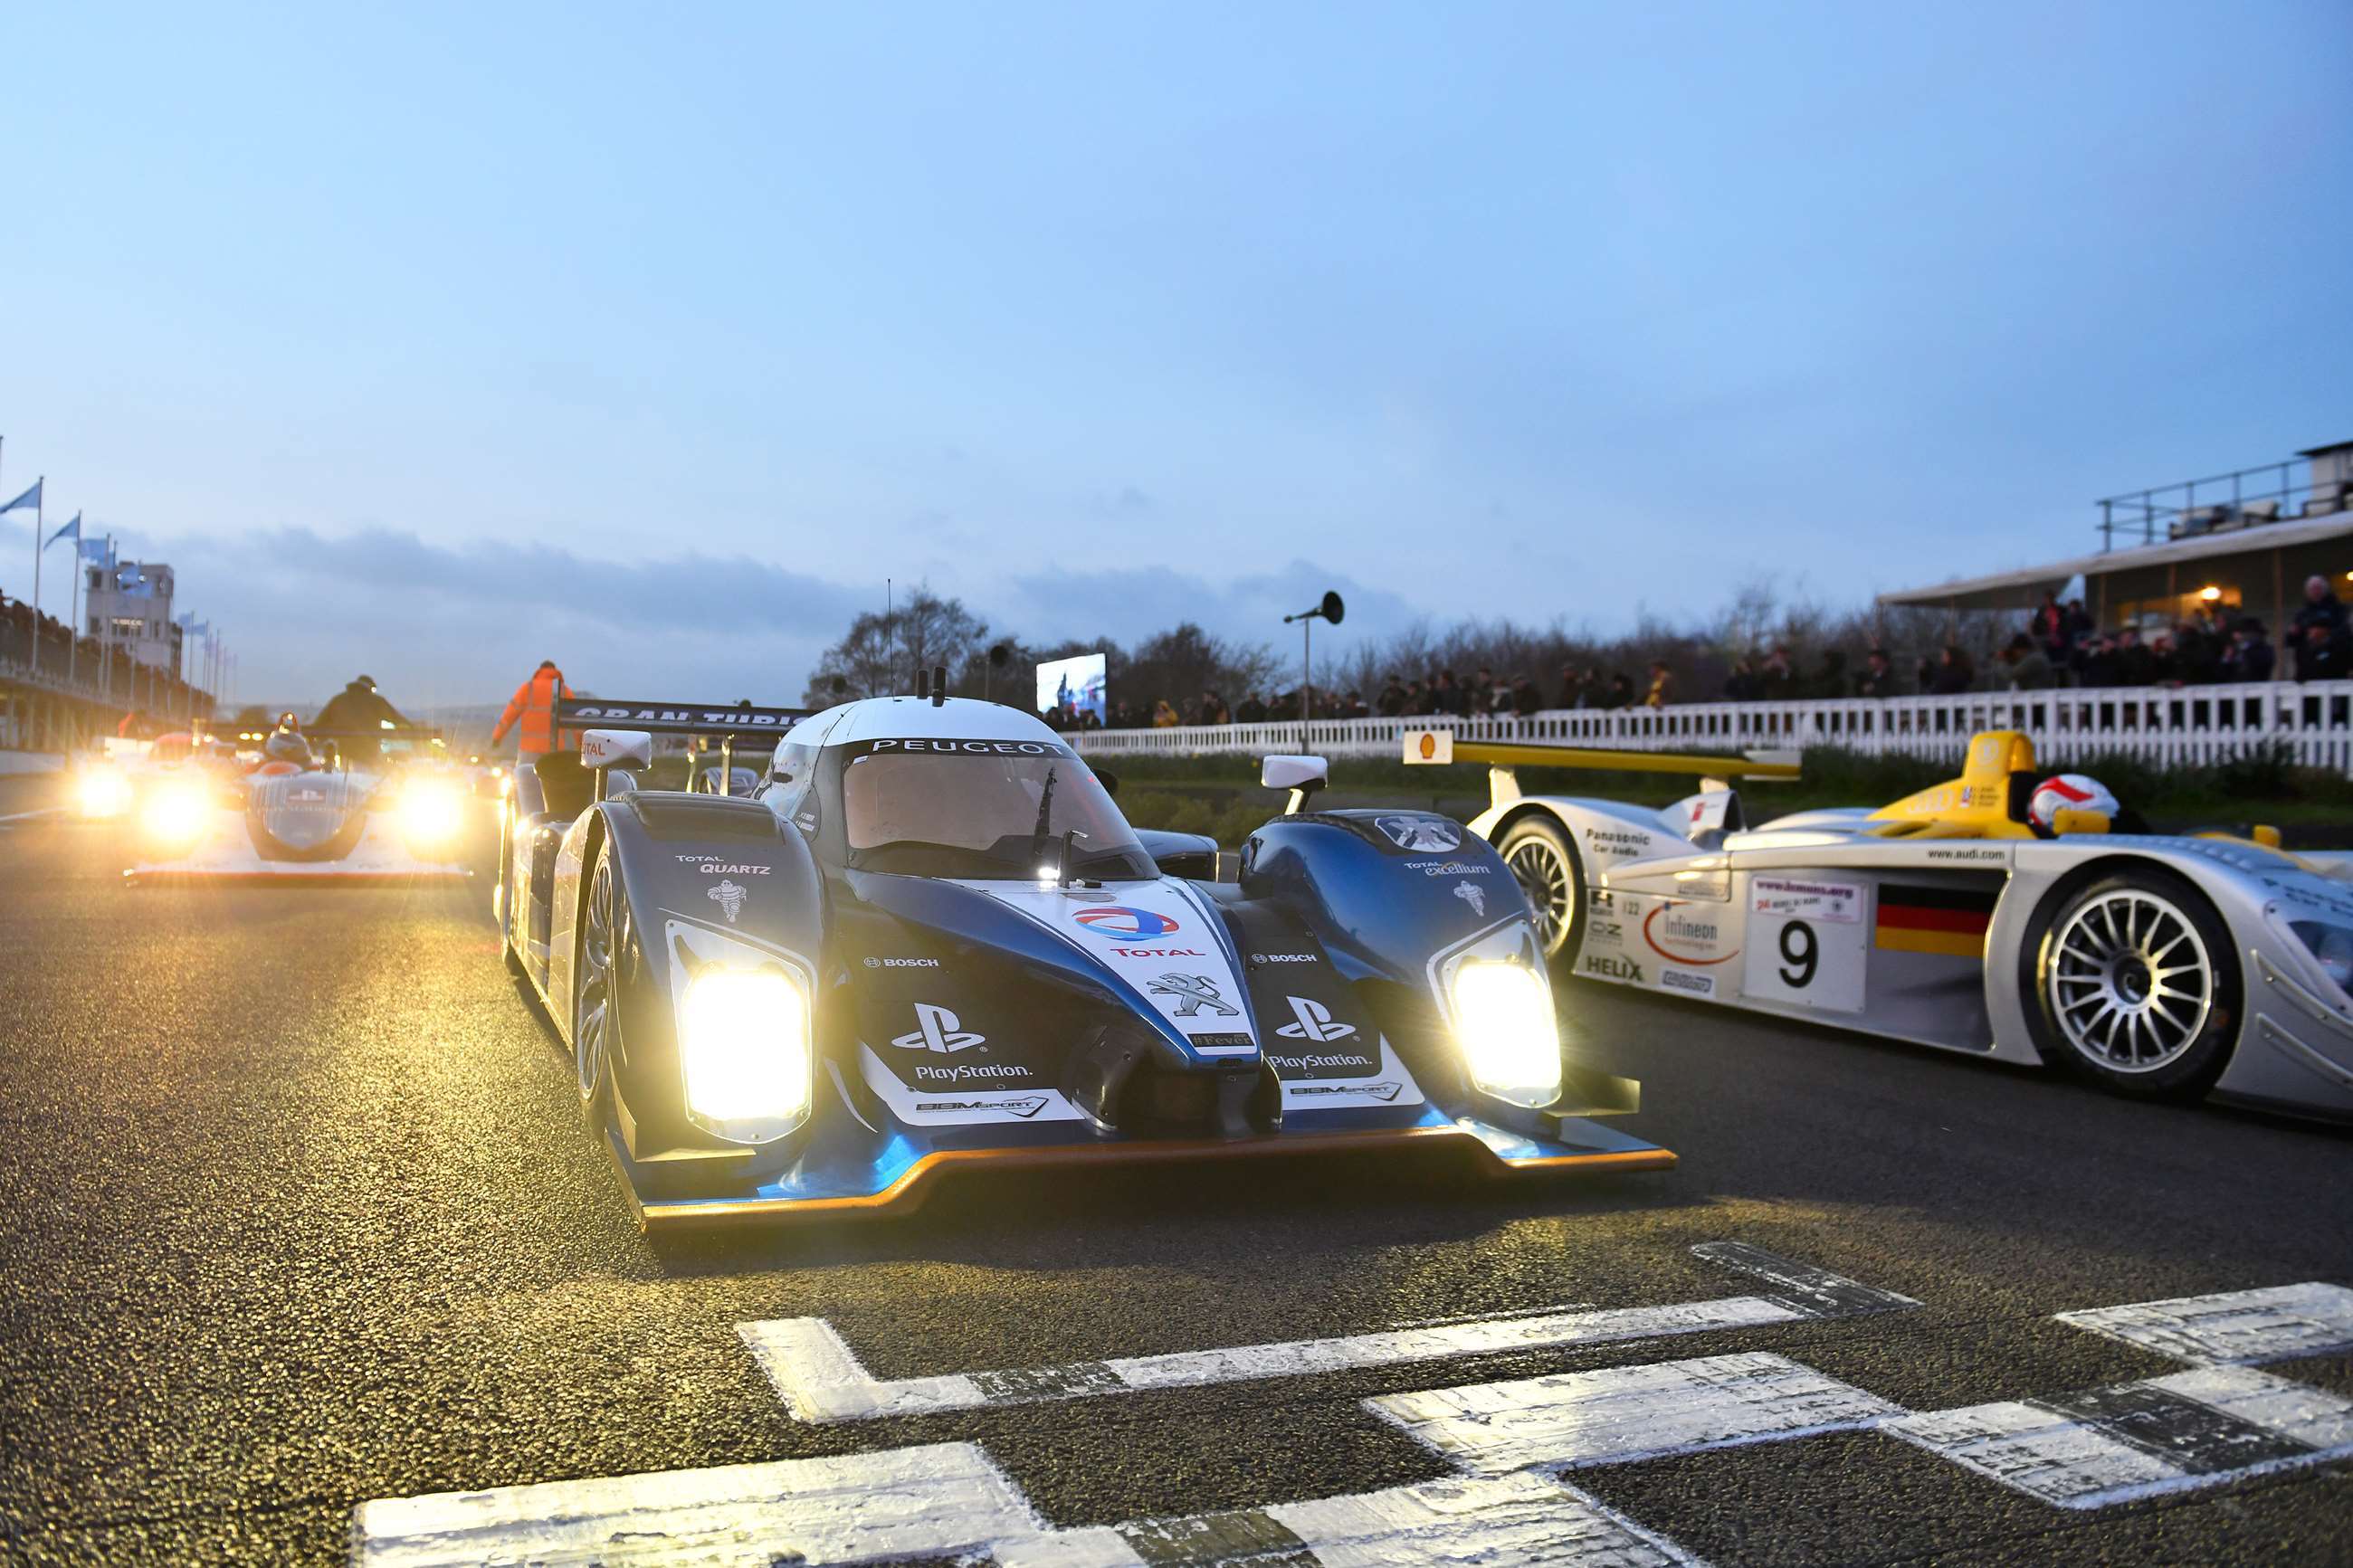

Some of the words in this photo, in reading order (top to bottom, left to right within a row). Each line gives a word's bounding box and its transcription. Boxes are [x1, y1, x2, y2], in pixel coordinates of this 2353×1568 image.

[872, 739, 1066, 755] PEUGEOT
[1586, 828, 1651, 845] Panasonic
[1593, 843, 1608, 853] Car
[1612, 845, 1639, 857] Audio
[1928, 849, 2005, 860] www.audi.com
[700, 863, 771, 875] QUARTZ
[1405, 861, 1443, 870] TOTAL
[1424, 862, 1491, 876] excellium
[1664, 914, 1718, 940] Infineon
[1110, 948, 1207, 957] TOTAL
[1268, 954, 1318, 963] BOSCH
[1779, 919, 1819, 989] 9
[883, 958, 939, 967] BOSCH
[1586, 955, 1643, 981] HELIX
